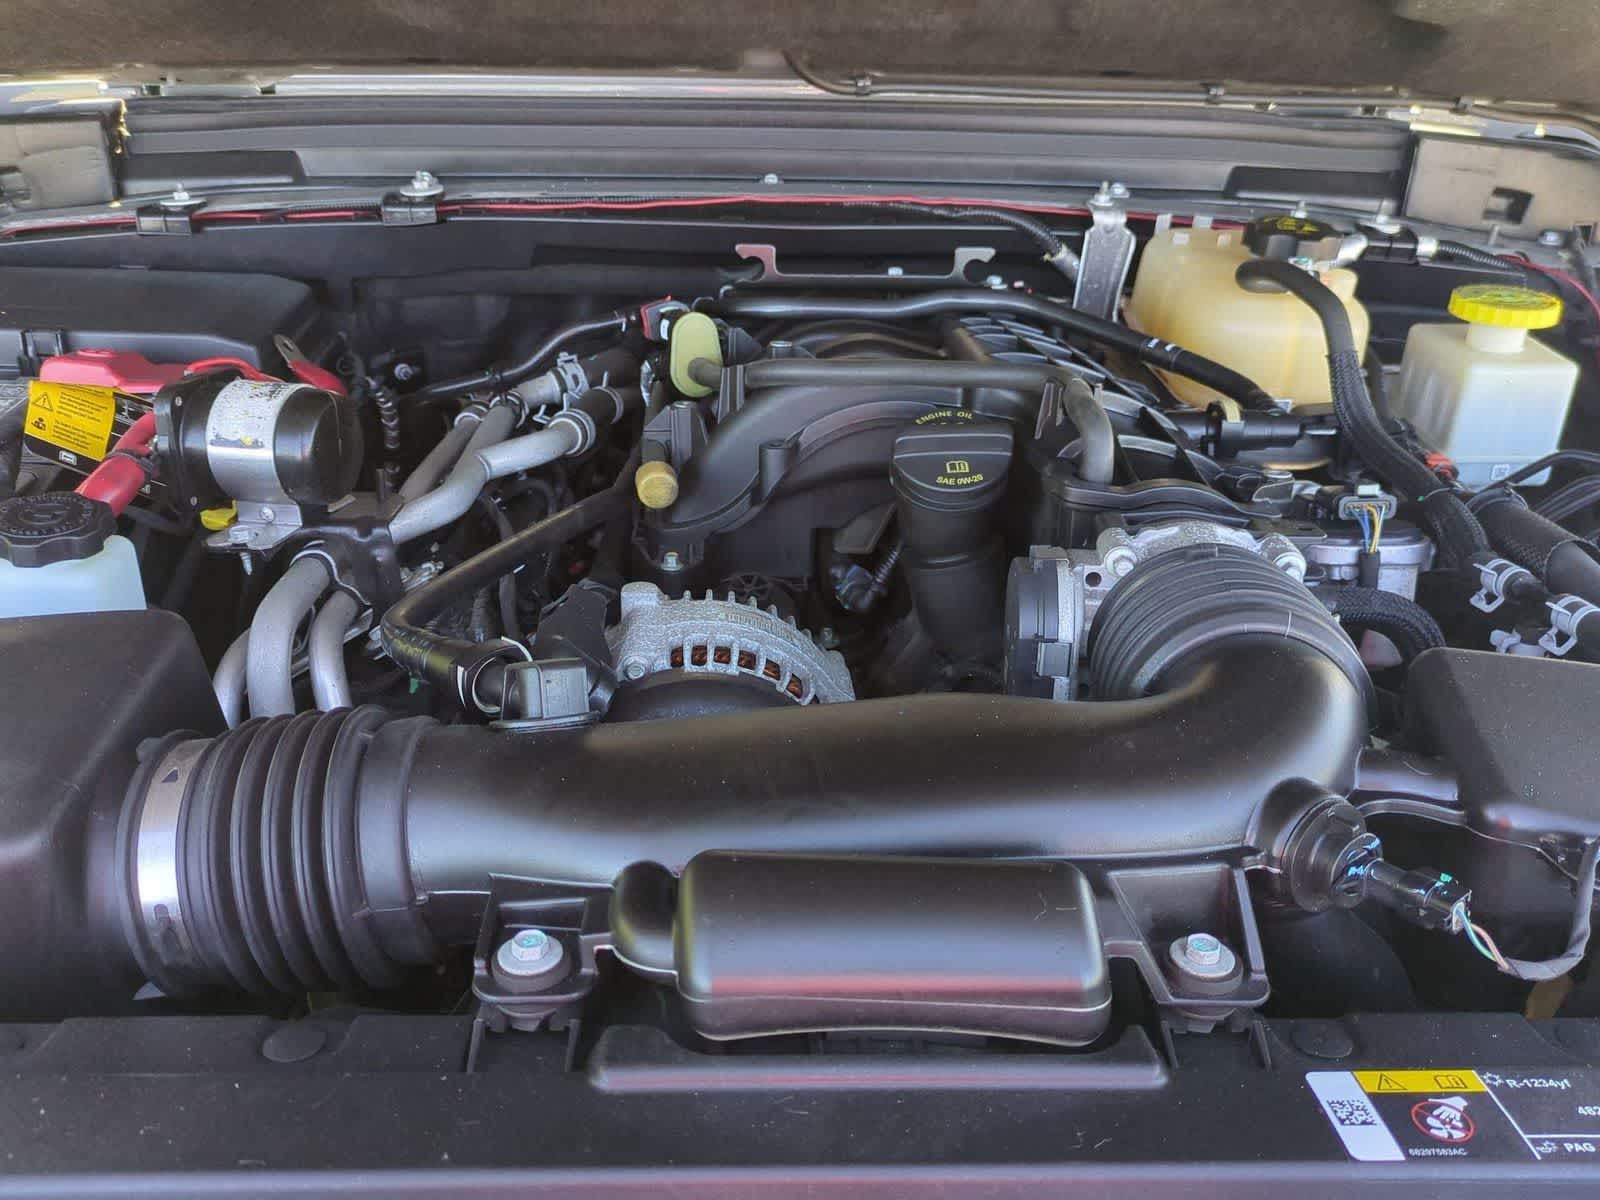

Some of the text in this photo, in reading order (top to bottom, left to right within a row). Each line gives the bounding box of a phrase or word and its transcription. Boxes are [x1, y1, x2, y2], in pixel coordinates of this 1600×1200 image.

[916, 410, 973, 424] ENGINE OIL
[936, 476, 955, 485] SAE
[1506, 1078, 1571, 1090] R-1234yf
[1563, 1142, 1597, 1153] PAG
